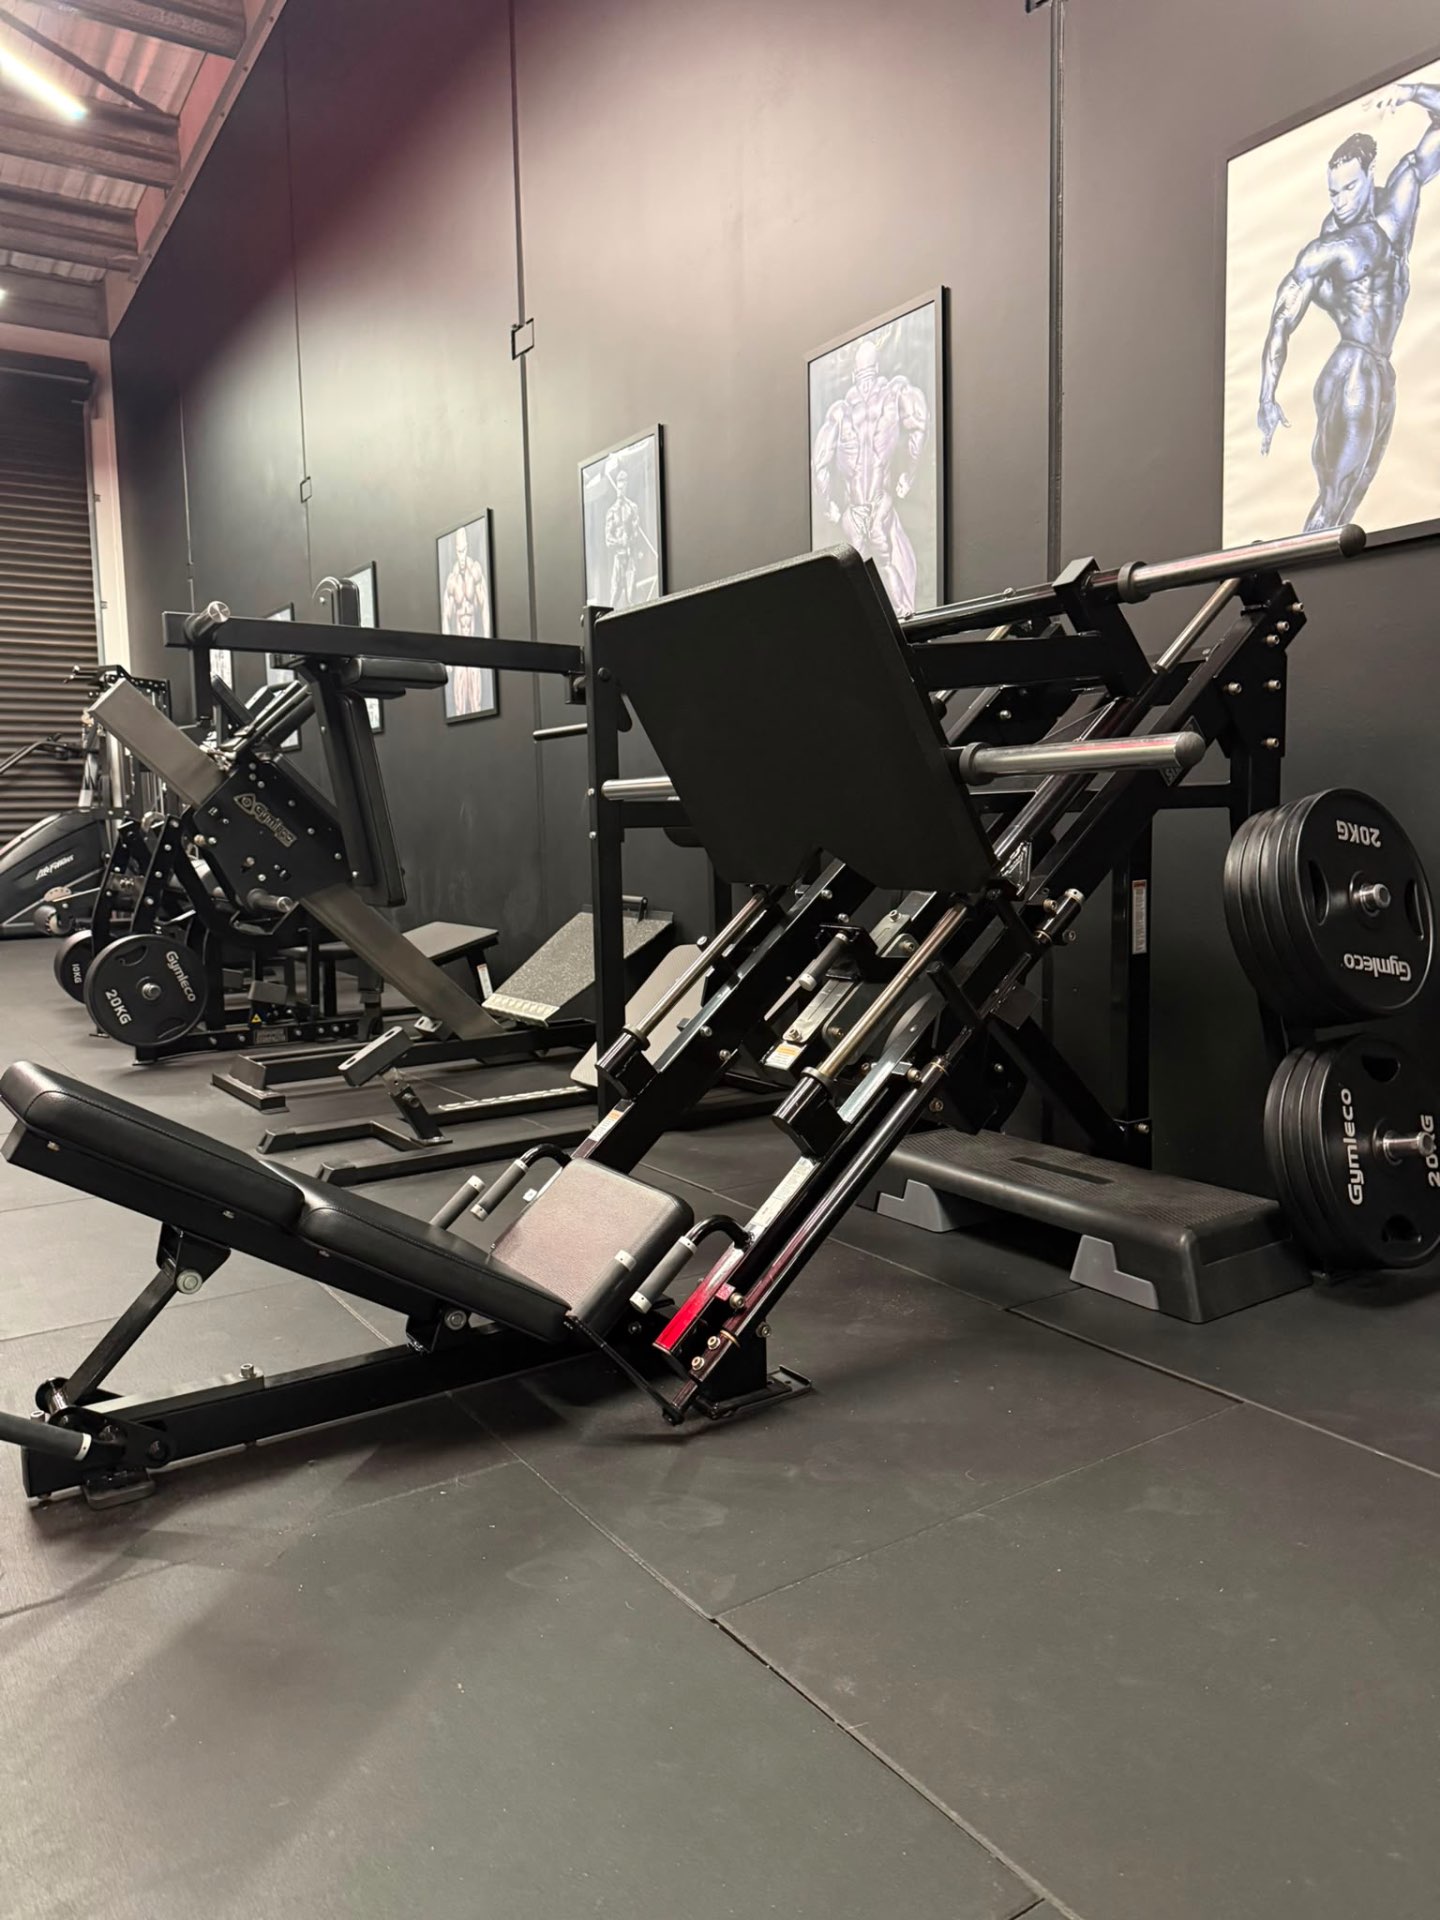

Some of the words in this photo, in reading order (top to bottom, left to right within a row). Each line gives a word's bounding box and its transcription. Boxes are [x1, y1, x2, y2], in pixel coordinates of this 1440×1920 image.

[1336, 820, 1381, 848] 20KG
[72, 963, 82, 984] 10KG
[166, 951, 196, 1002] Gymleco
[1343, 953, 1411, 982] Gymleco
[105, 989, 132, 1025] 20KG
[1341, 1088, 1365, 1206] Gymleco
[1420, 1114, 1440, 1188] 20G
